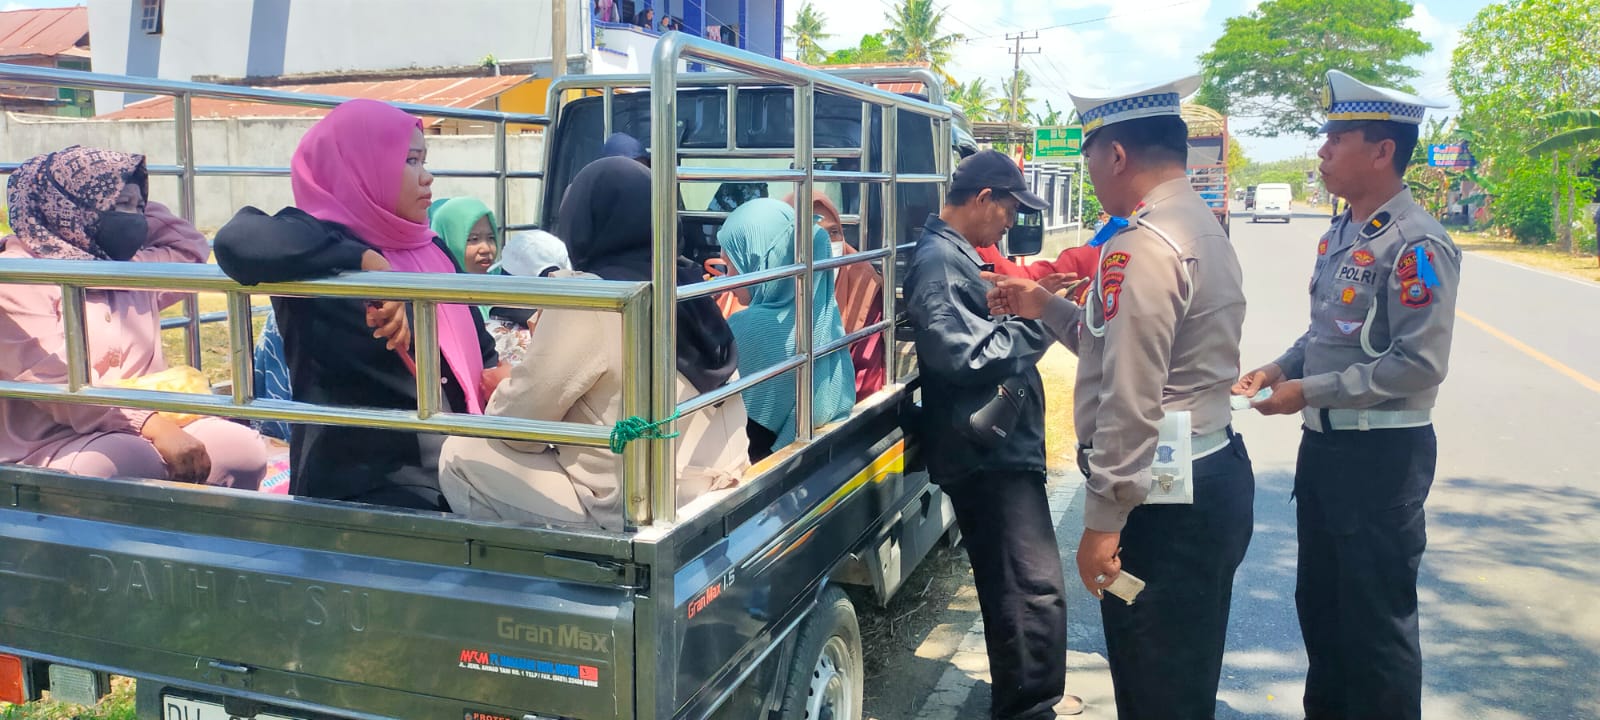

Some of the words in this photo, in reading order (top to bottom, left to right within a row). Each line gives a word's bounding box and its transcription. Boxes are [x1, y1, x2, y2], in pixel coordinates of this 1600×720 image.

[1340, 266, 1376, 286] POLRI
[89, 553, 370, 632] DAIHATSU
[688, 595, 706, 619] Gran
[706, 582, 721, 605] Max
[723, 567, 735, 591] 1.5
[496, 616, 553, 645] Gran
[558, 624, 609, 653] Max
